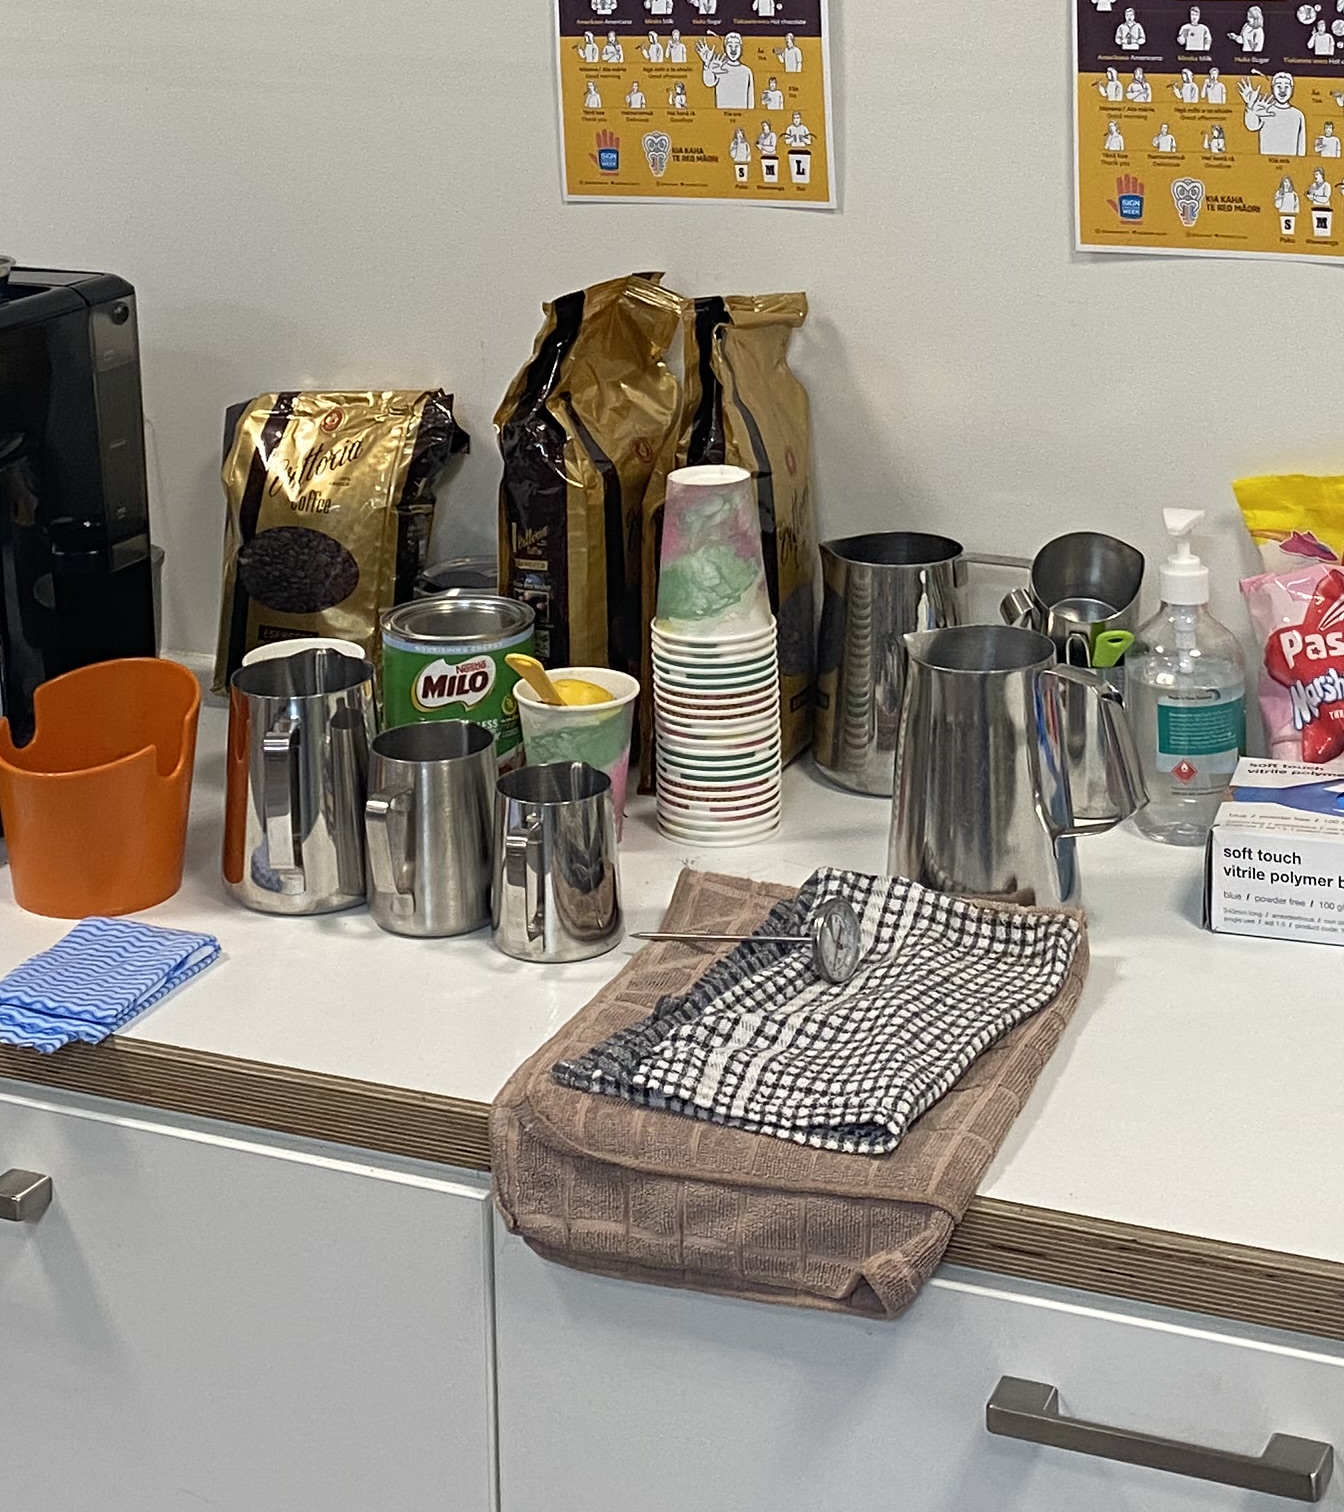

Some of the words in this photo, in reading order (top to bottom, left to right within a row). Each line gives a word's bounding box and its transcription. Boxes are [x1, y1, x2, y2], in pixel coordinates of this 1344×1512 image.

[738, 167, 745, 177] S
[765, 165, 775, 176] M
[795, 160, 806, 176] L
[1206, 195, 1219, 203] KIA
[1220, 195, 1244, 204] KAHA
[1207, 204, 1216, 212] TE
[1284, 218, 1291, 230] S
[1316, 217, 1328, 229] M
[421, 671, 489, 699] MILO
[1329, 709, 1344, 721] THE
[1282, 763, 1325, 771] touch
[1223, 847, 1253, 861] soft
[1257, 848, 1302, 865] touch
[1223, 865, 1266, 881] vitrile
[1269, 870, 1335, 888] polymer
[1223, 890, 1242, 901] blue
[1254, 895, 1287, 906] powder
[1288, 897, 1306, 907] free
[1319, 900, 1336, 911] 100
